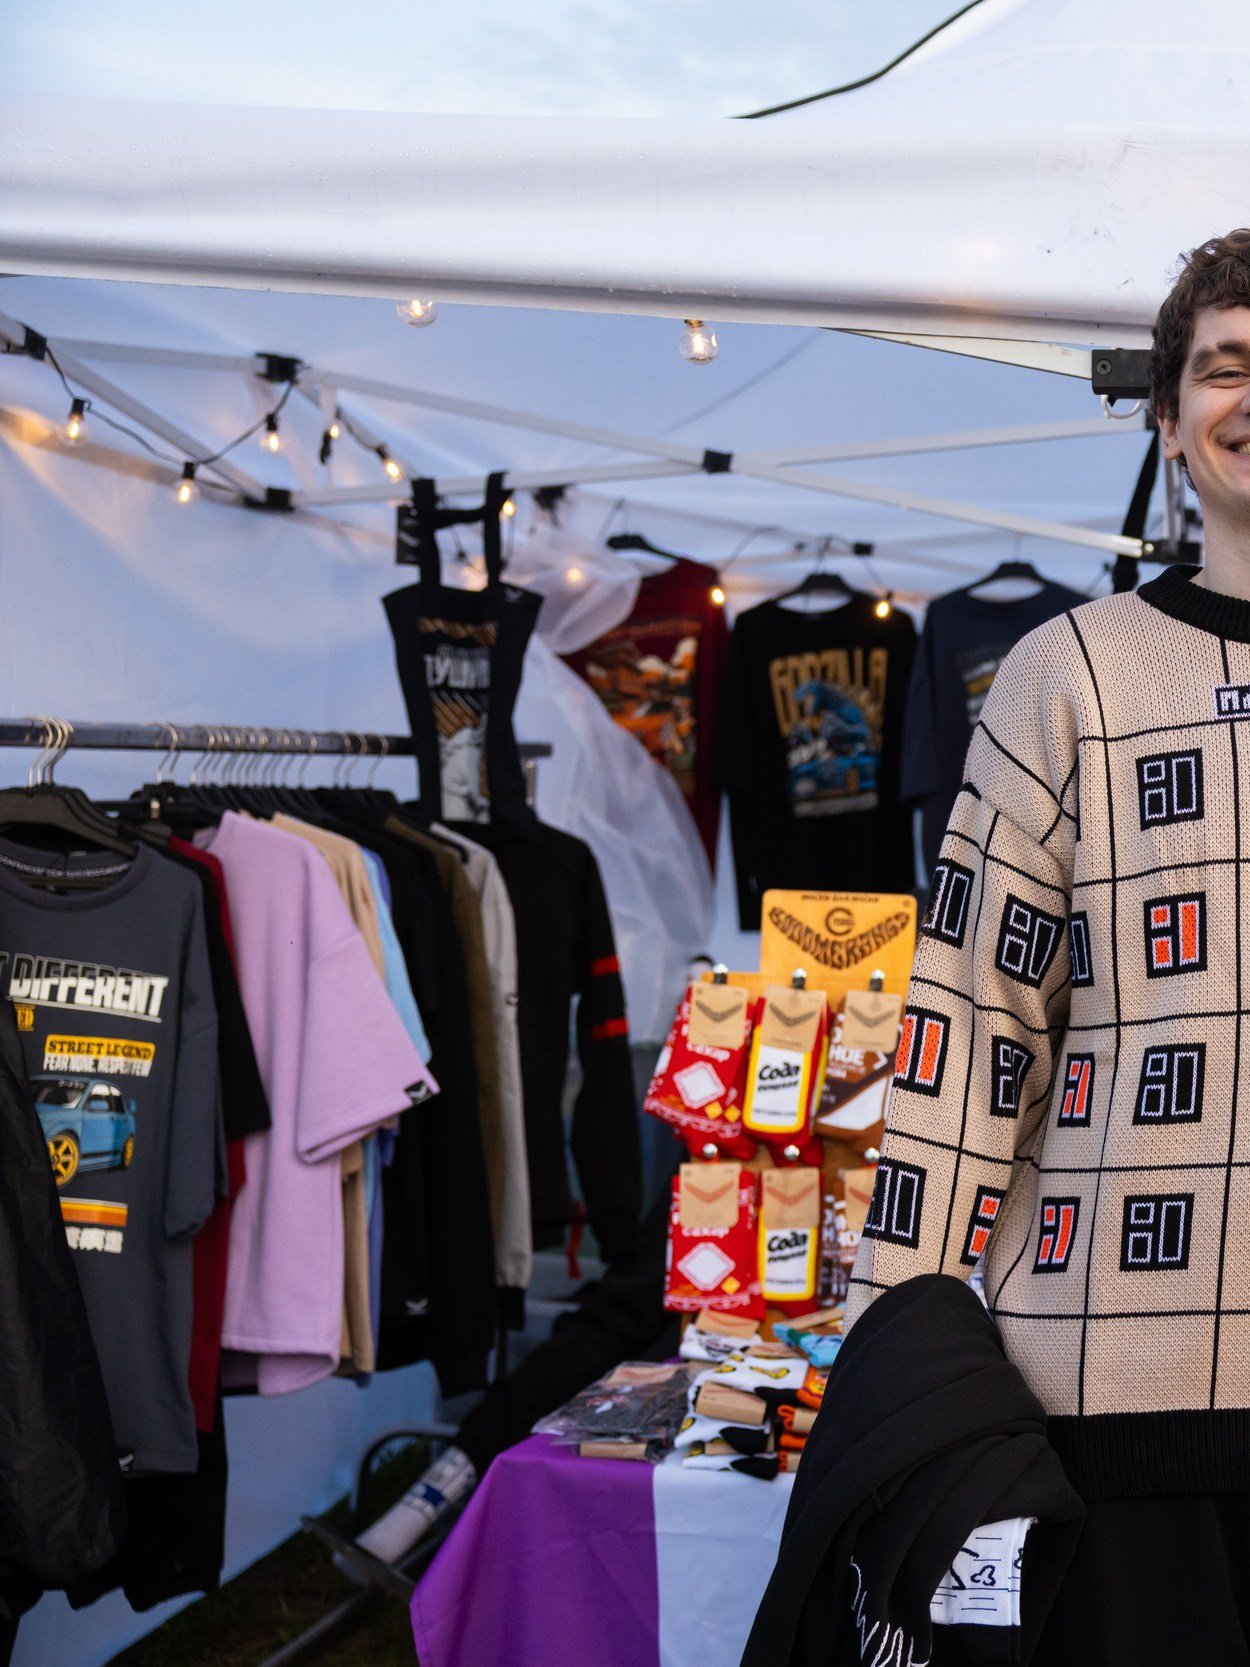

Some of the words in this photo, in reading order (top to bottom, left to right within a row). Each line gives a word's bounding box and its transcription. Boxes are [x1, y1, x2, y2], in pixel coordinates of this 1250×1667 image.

[9, 953, 169, 1018] DIFFERENT
[49, 1040, 104, 1056] STREET
[106, 1044, 153, 1059] LEGEND
